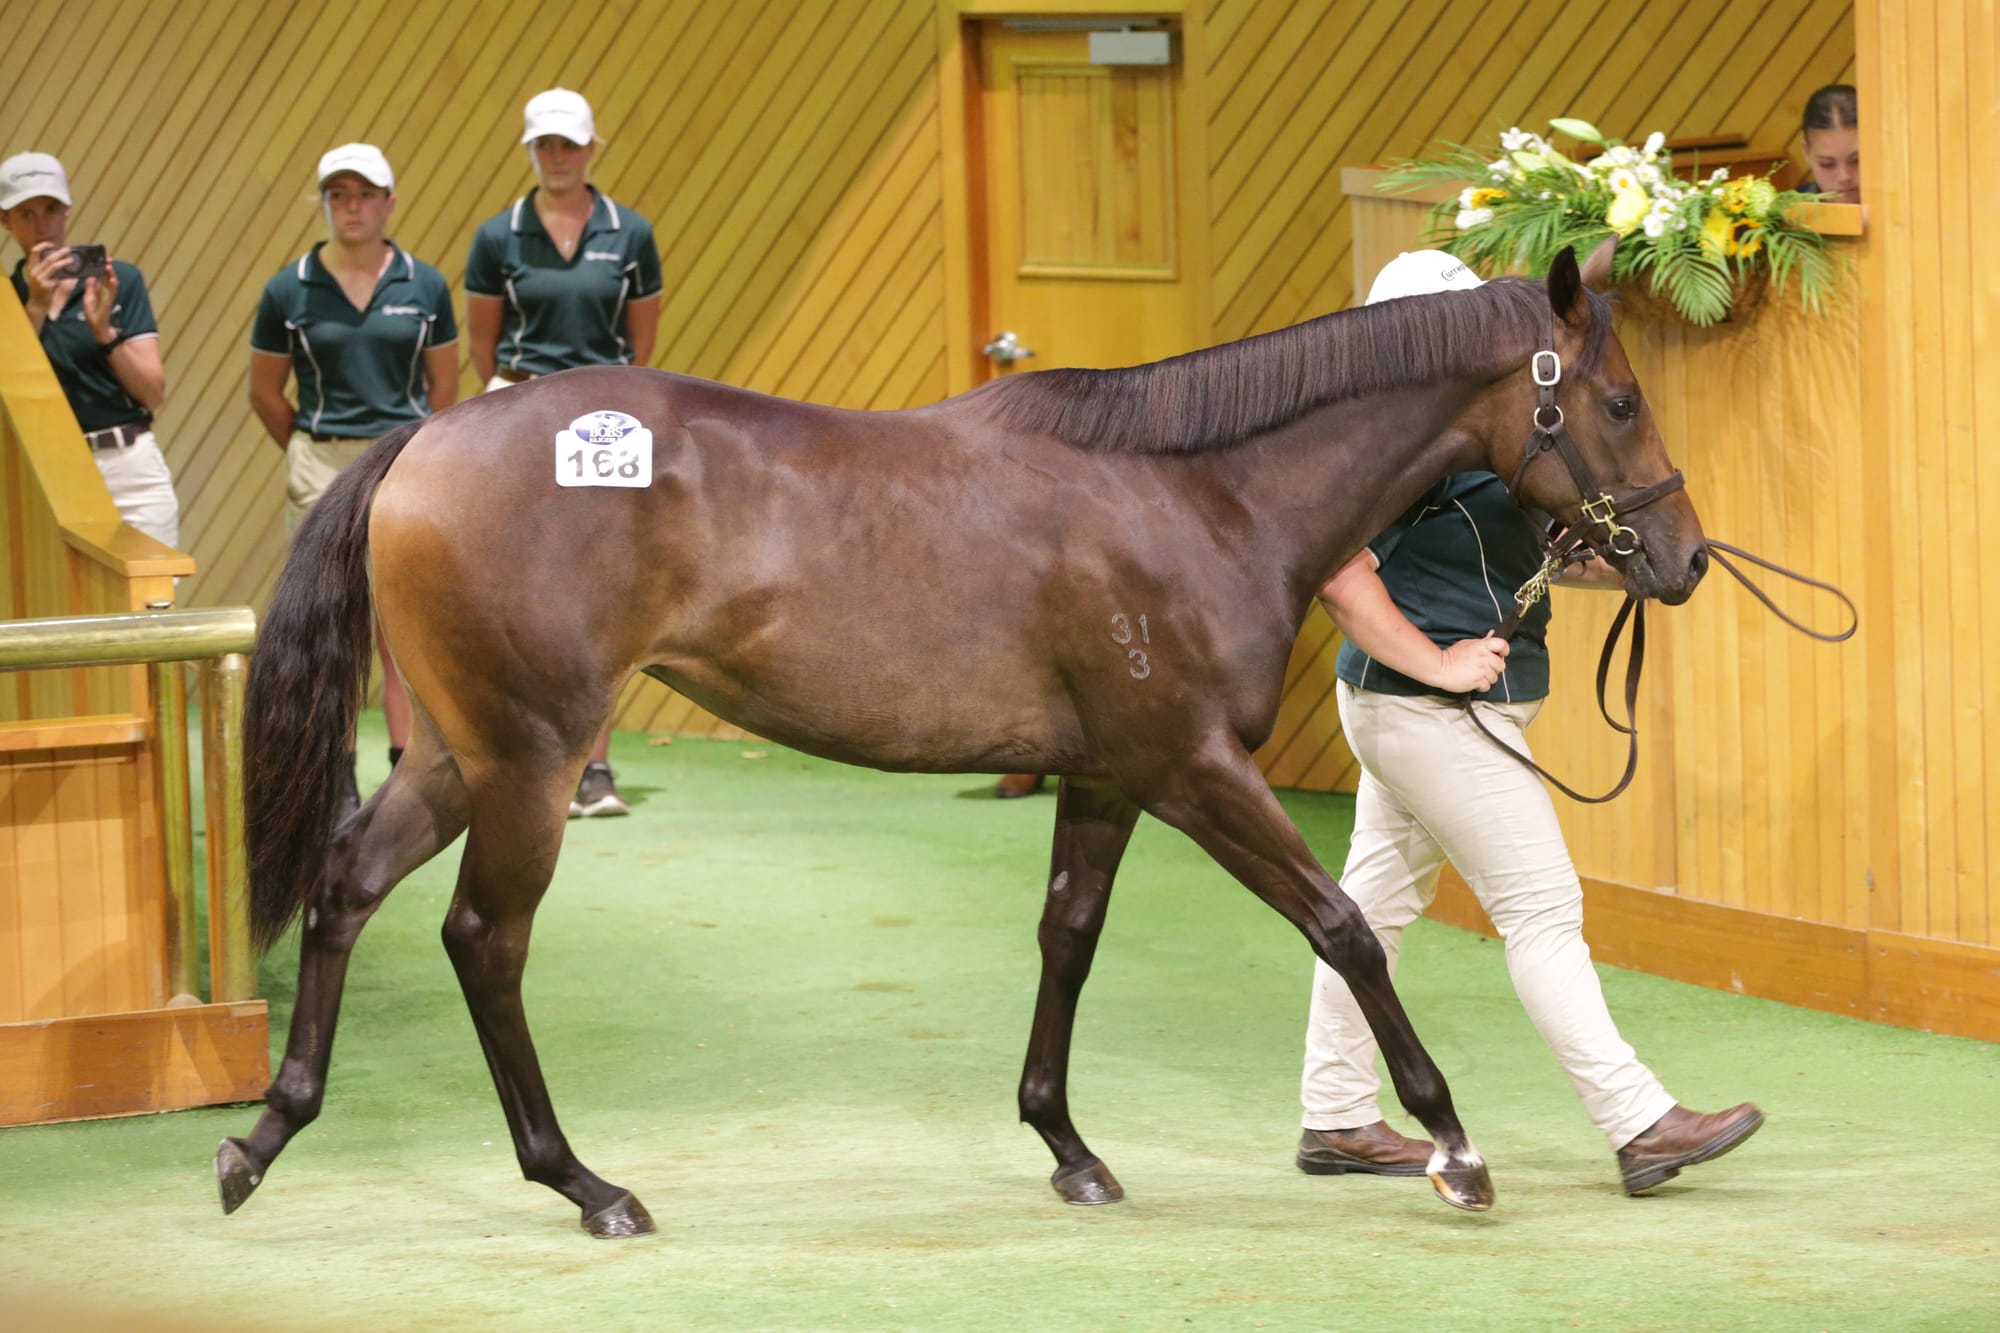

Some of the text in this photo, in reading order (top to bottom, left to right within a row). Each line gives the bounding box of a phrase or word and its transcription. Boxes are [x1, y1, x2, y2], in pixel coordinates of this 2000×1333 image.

[589, 427, 624, 438] BOBS
[567, 449, 640, 479] 168
[1128, 648, 1151, 680] 3
